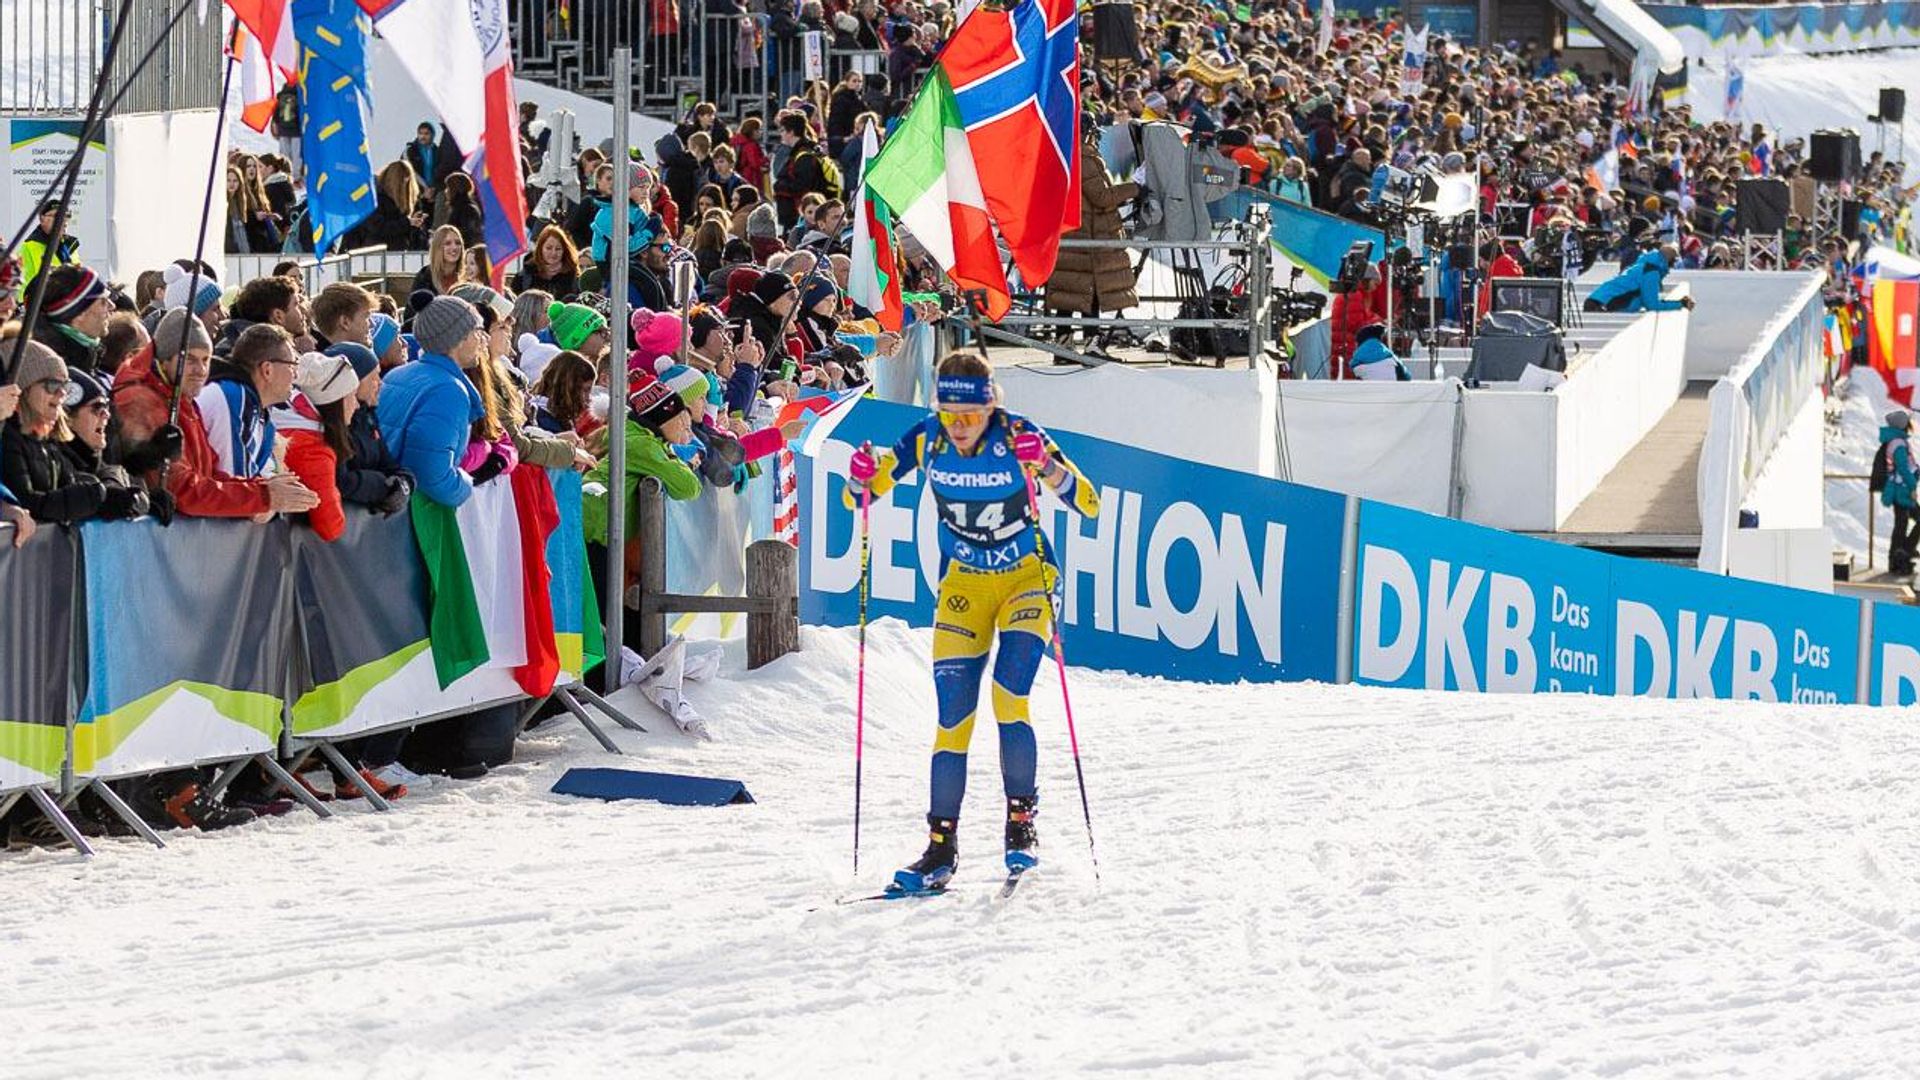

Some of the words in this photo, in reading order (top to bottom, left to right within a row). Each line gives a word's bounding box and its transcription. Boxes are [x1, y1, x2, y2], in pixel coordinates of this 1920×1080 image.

[930, 469, 1013, 488] DECATHLON
[946, 502, 1005, 531] 14
[809, 439, 1287, 665] DEHLON
[1359, 543, 1538, 694] DKB
[1551, 585, 1590, 629] Das
[1550, 631, 1599, 676] kann
[1615, 599, 1779, 704] DKB
[1793, 629, 1830, 668] Das
